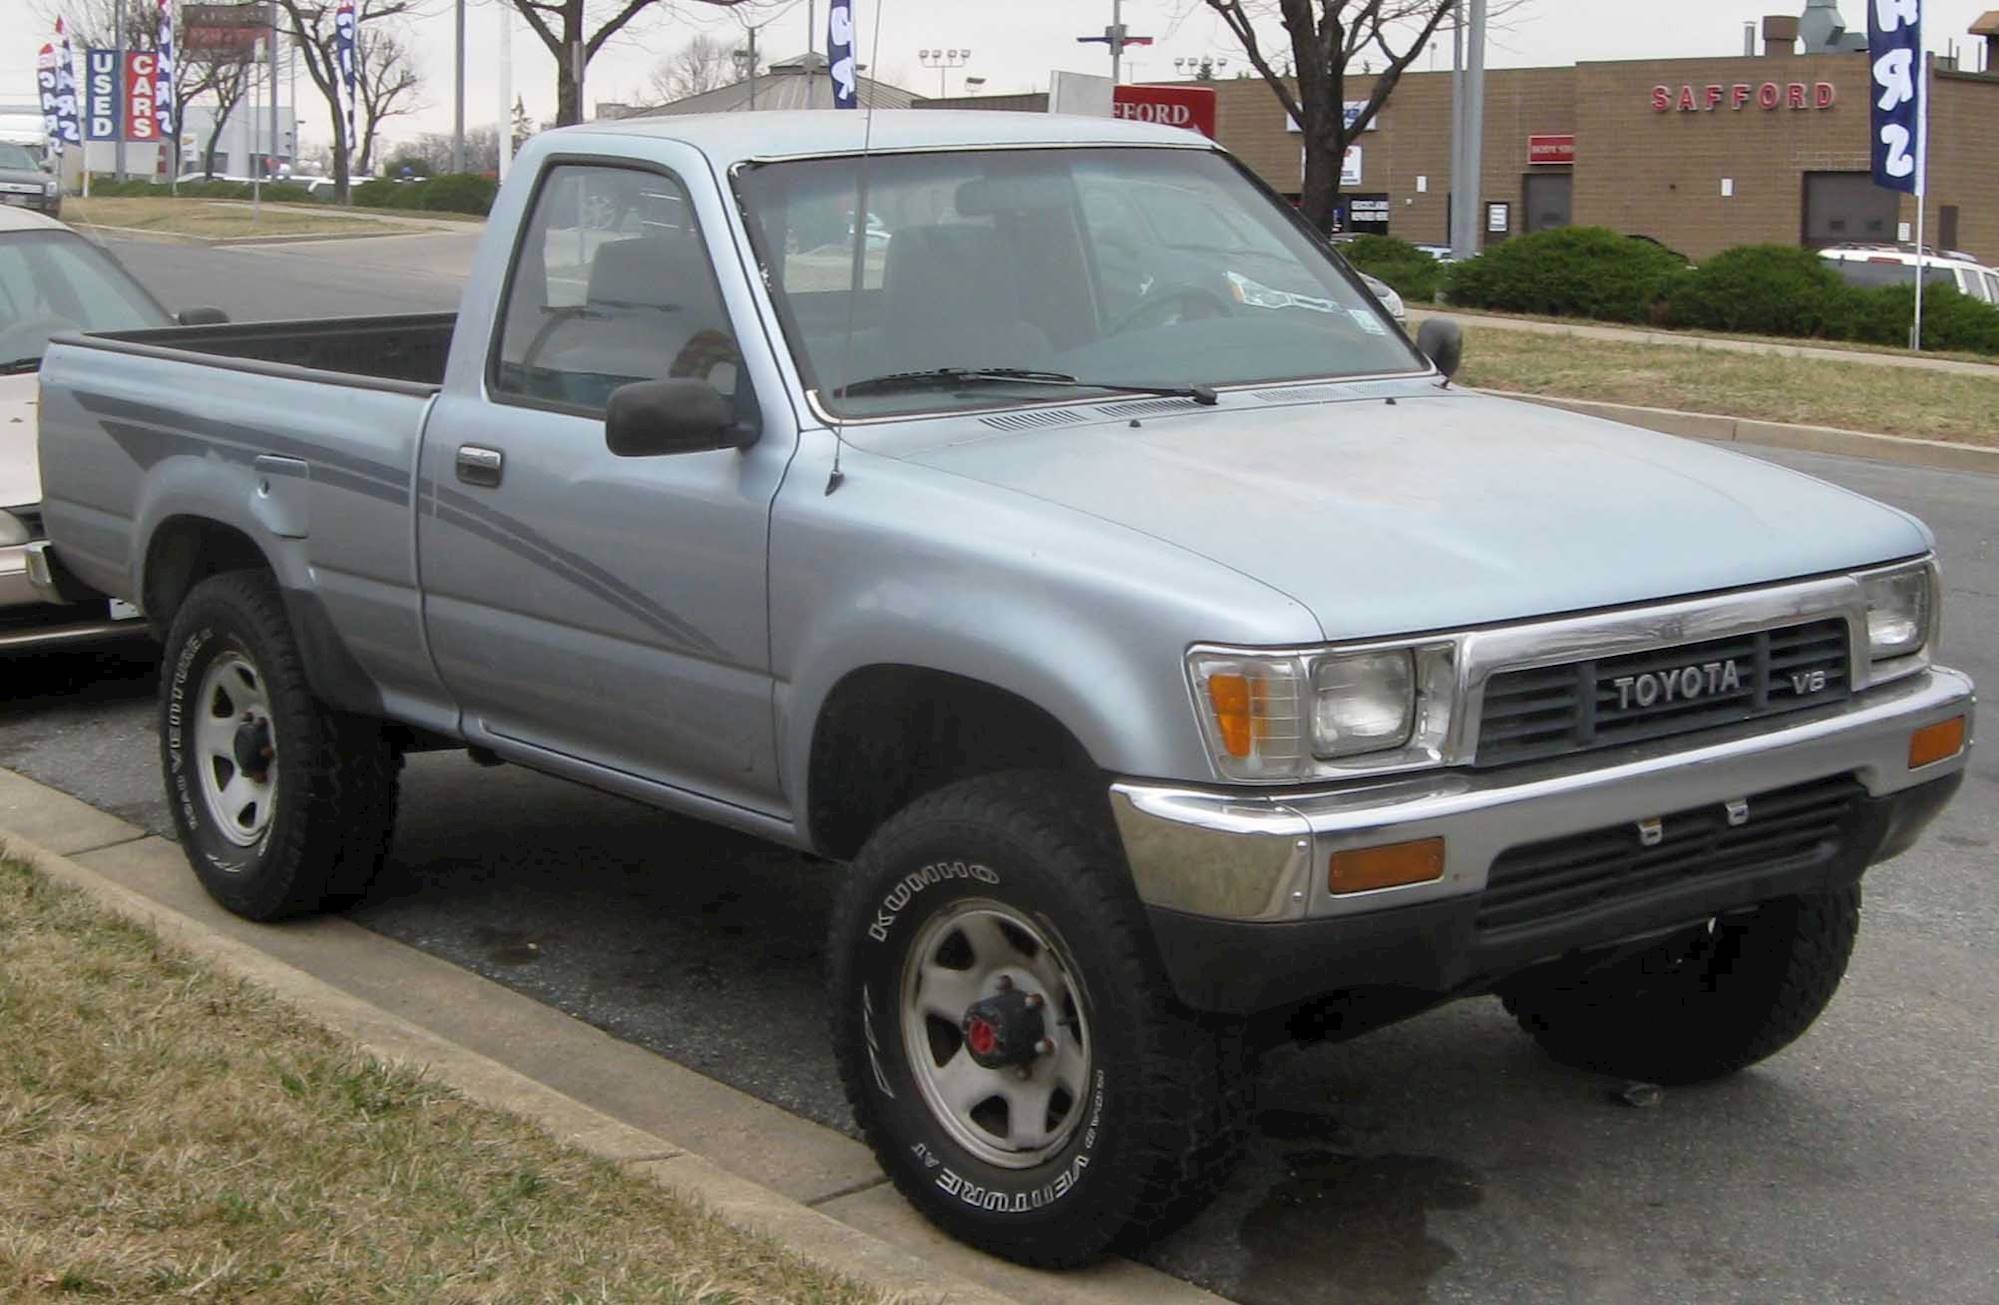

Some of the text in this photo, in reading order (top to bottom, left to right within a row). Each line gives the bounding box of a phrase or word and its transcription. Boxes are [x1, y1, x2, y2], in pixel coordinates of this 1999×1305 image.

[92, 54, 153, 138] USED CARS
[1651, 82, 1836, 112] SAFFORD
[1614, 660, 1825, 710] TOYOTA V6
[868, 862, 1001, 942] KUMHO
[935, 1155, 1090, 1212] VENTURE
